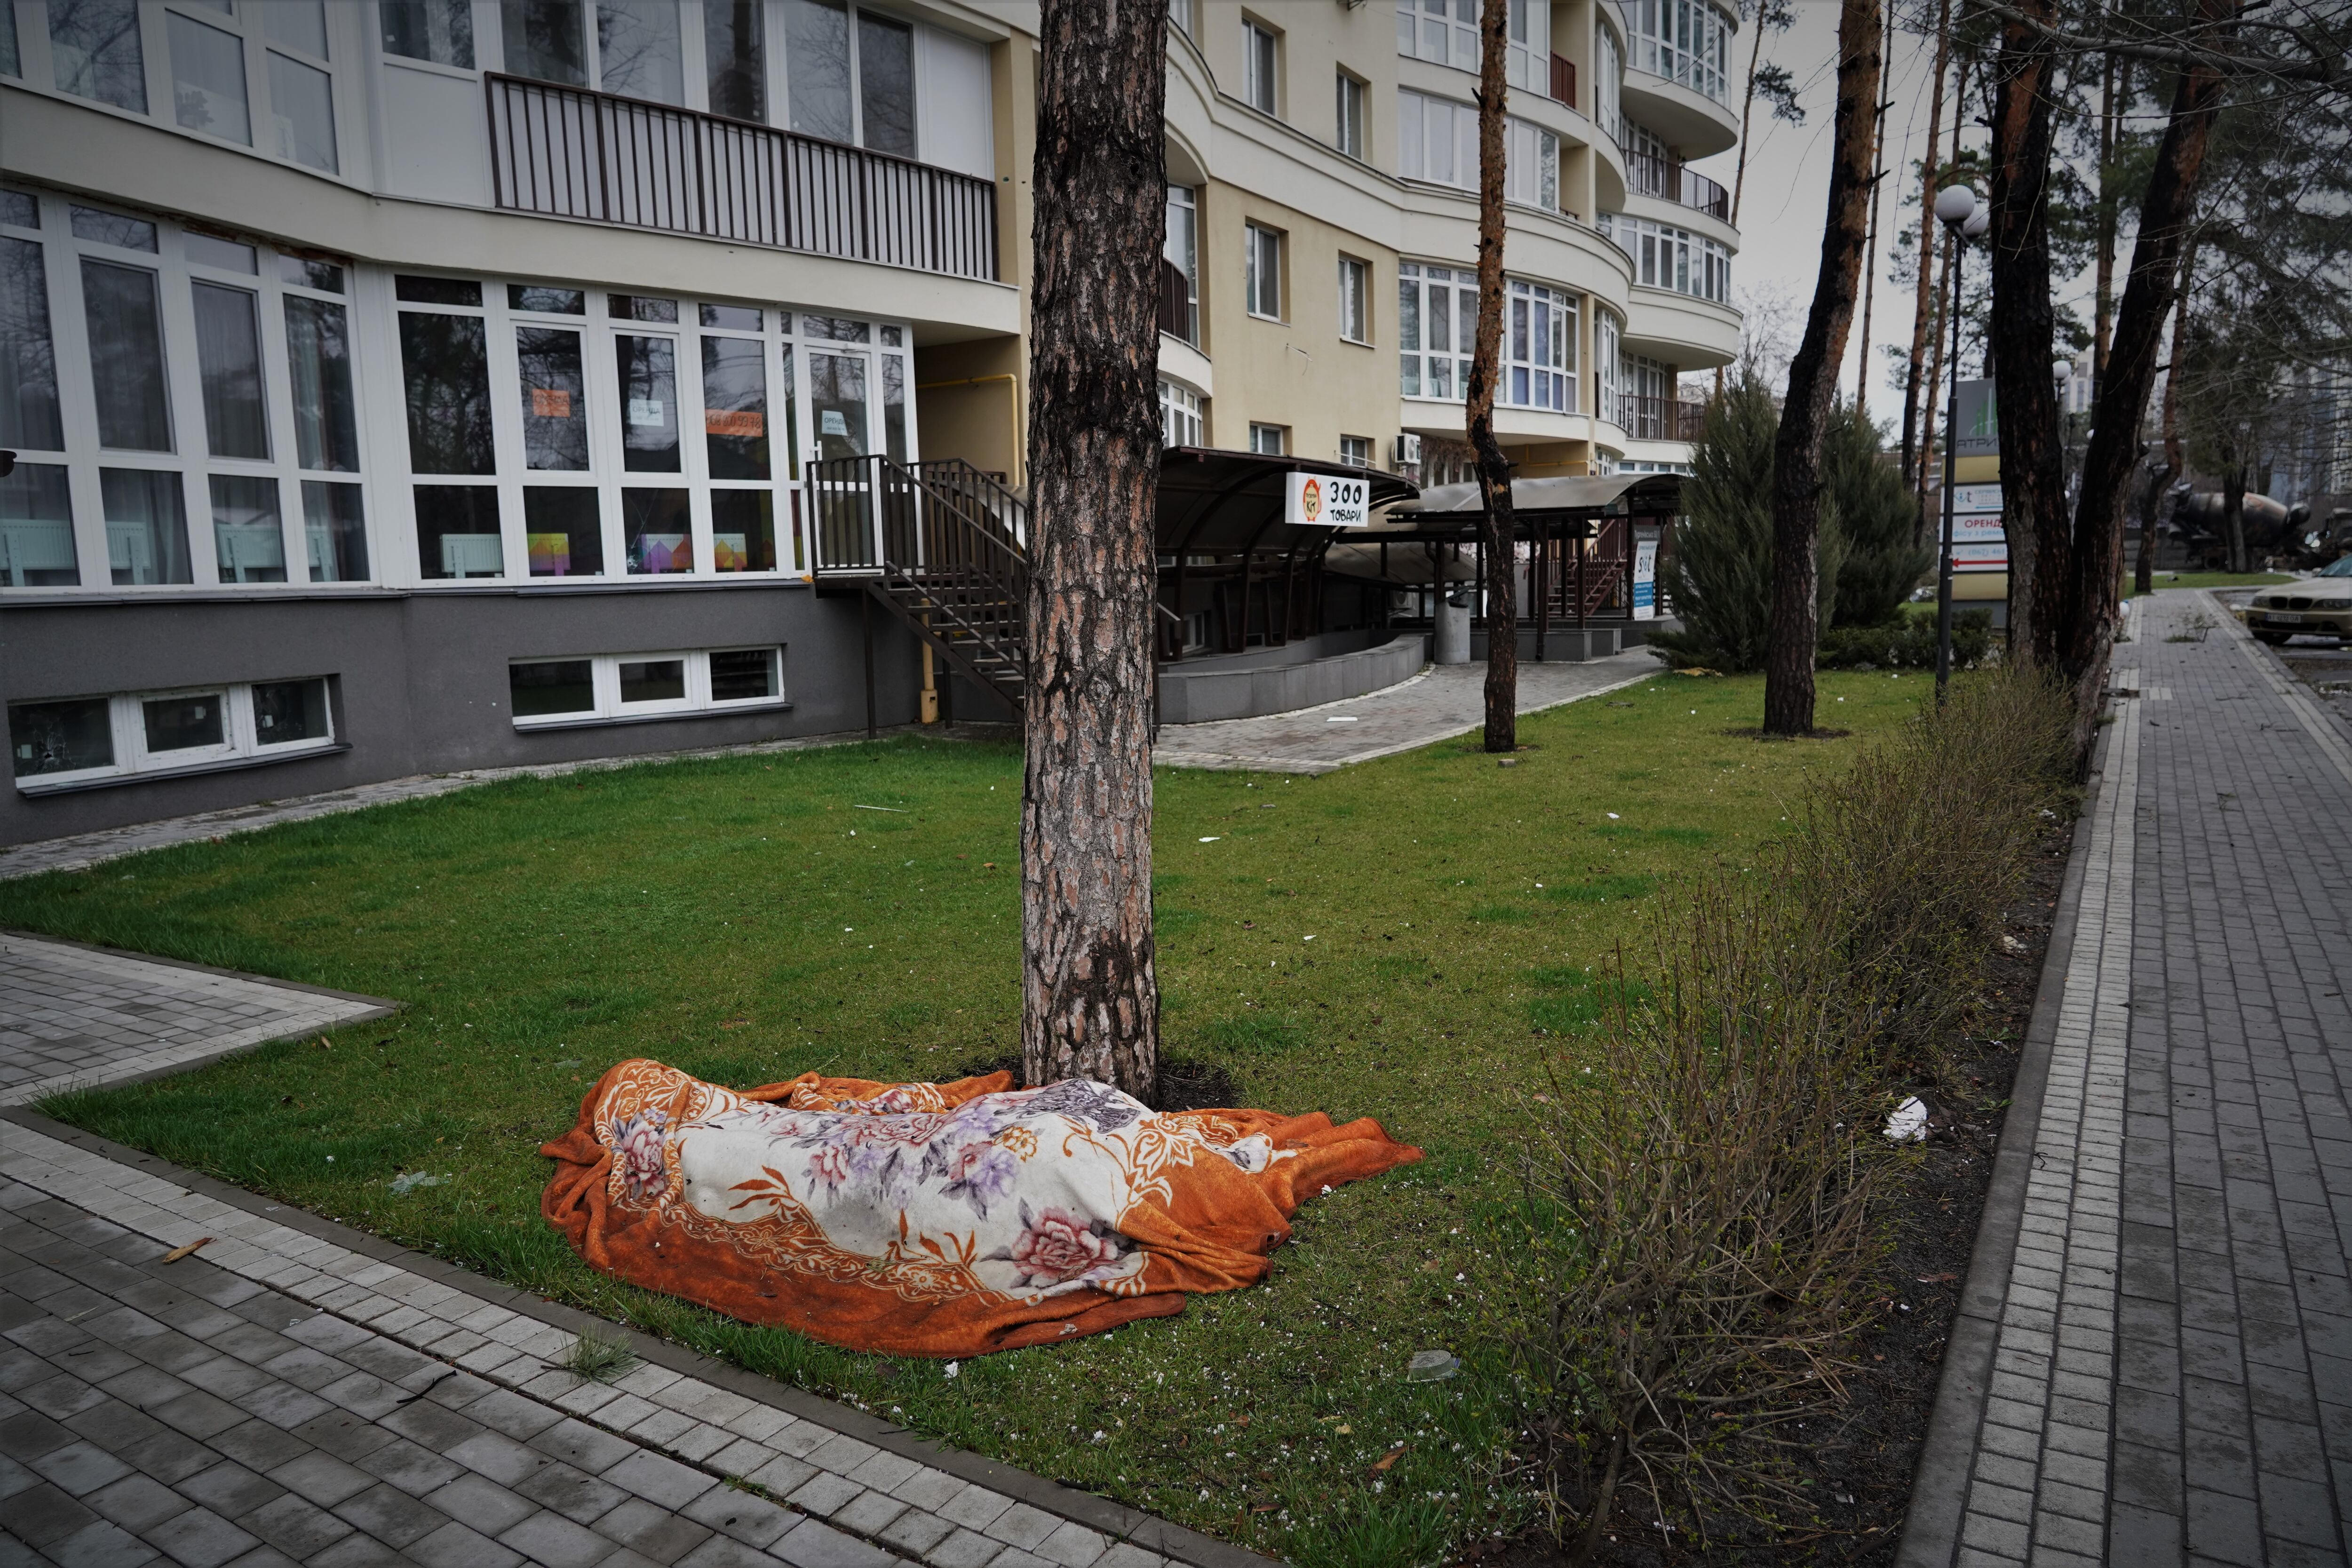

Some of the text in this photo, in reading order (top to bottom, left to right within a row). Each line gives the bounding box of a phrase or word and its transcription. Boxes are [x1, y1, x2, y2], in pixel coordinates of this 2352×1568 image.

[1956, 438, 1997, 448] АТРИ
[1330, 482, 1362, 504] ЗОО
[1330, 509, 1361, 522] ТОВАРИ
[1964, 519, 2001, 528] ОРЕНД
